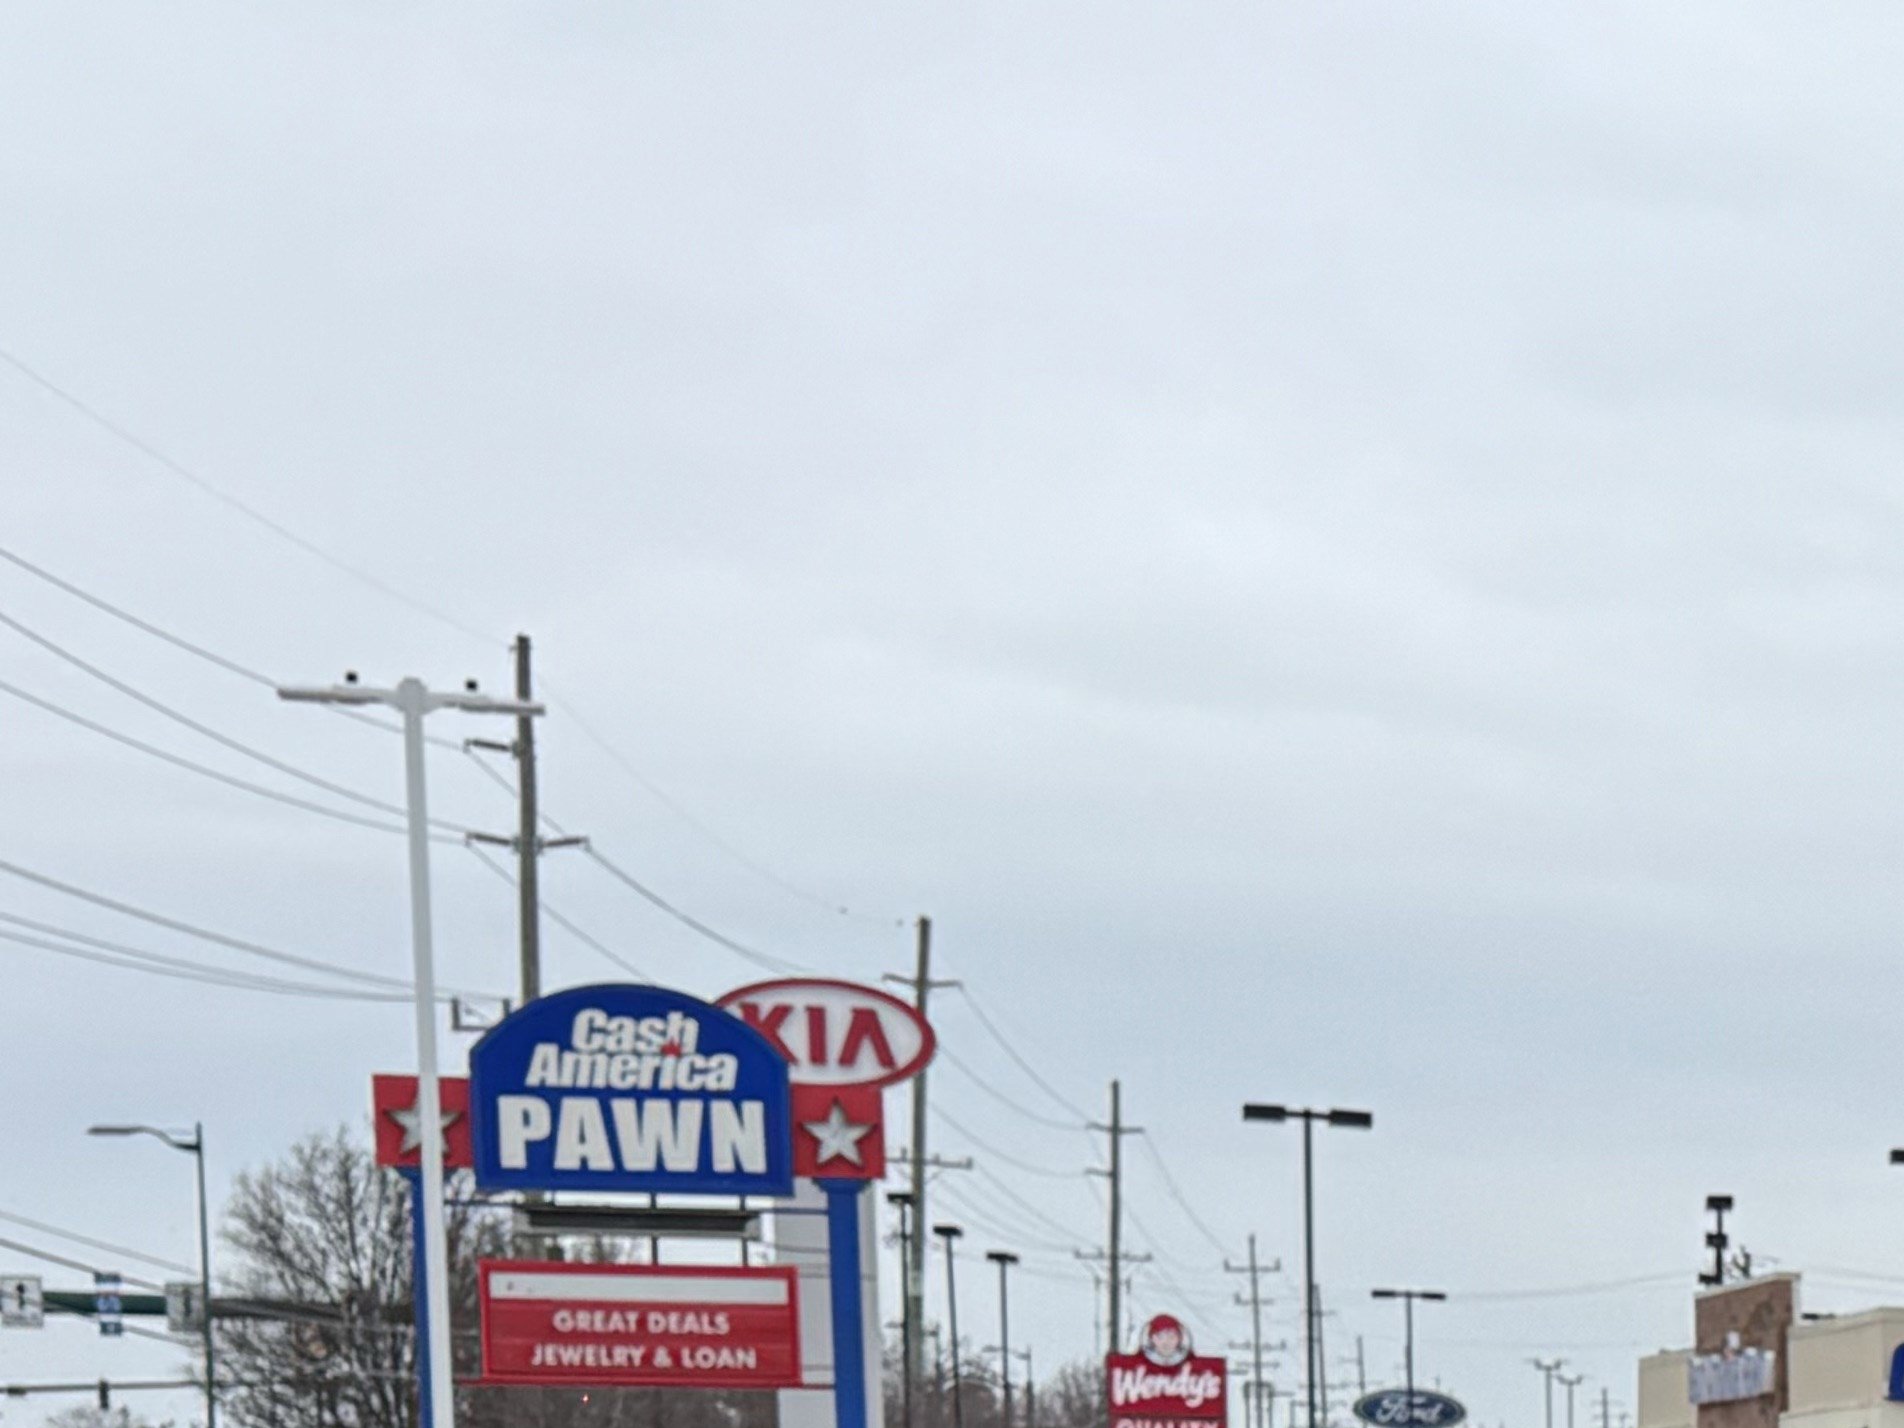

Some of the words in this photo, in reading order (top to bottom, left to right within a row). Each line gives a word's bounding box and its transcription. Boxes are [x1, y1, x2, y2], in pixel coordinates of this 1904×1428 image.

[571, 1008, 699, 1054] Cash
[739, 1002, 897, 1069] KIA
[525, 1043, 738, 1091] America
[497, 1095, 768, 1174] PAWN
[553, 1310, 639, 1334] GREAT
[647, 1311, 730, 1335] DEALS
[531, 1343, 646, 1368] JEWELRY
[653, 1346, 673, 1368] &
[681, 1347, 757, 1370] LOAN
[1112, 1361, 1222, 1409] Wendy's
